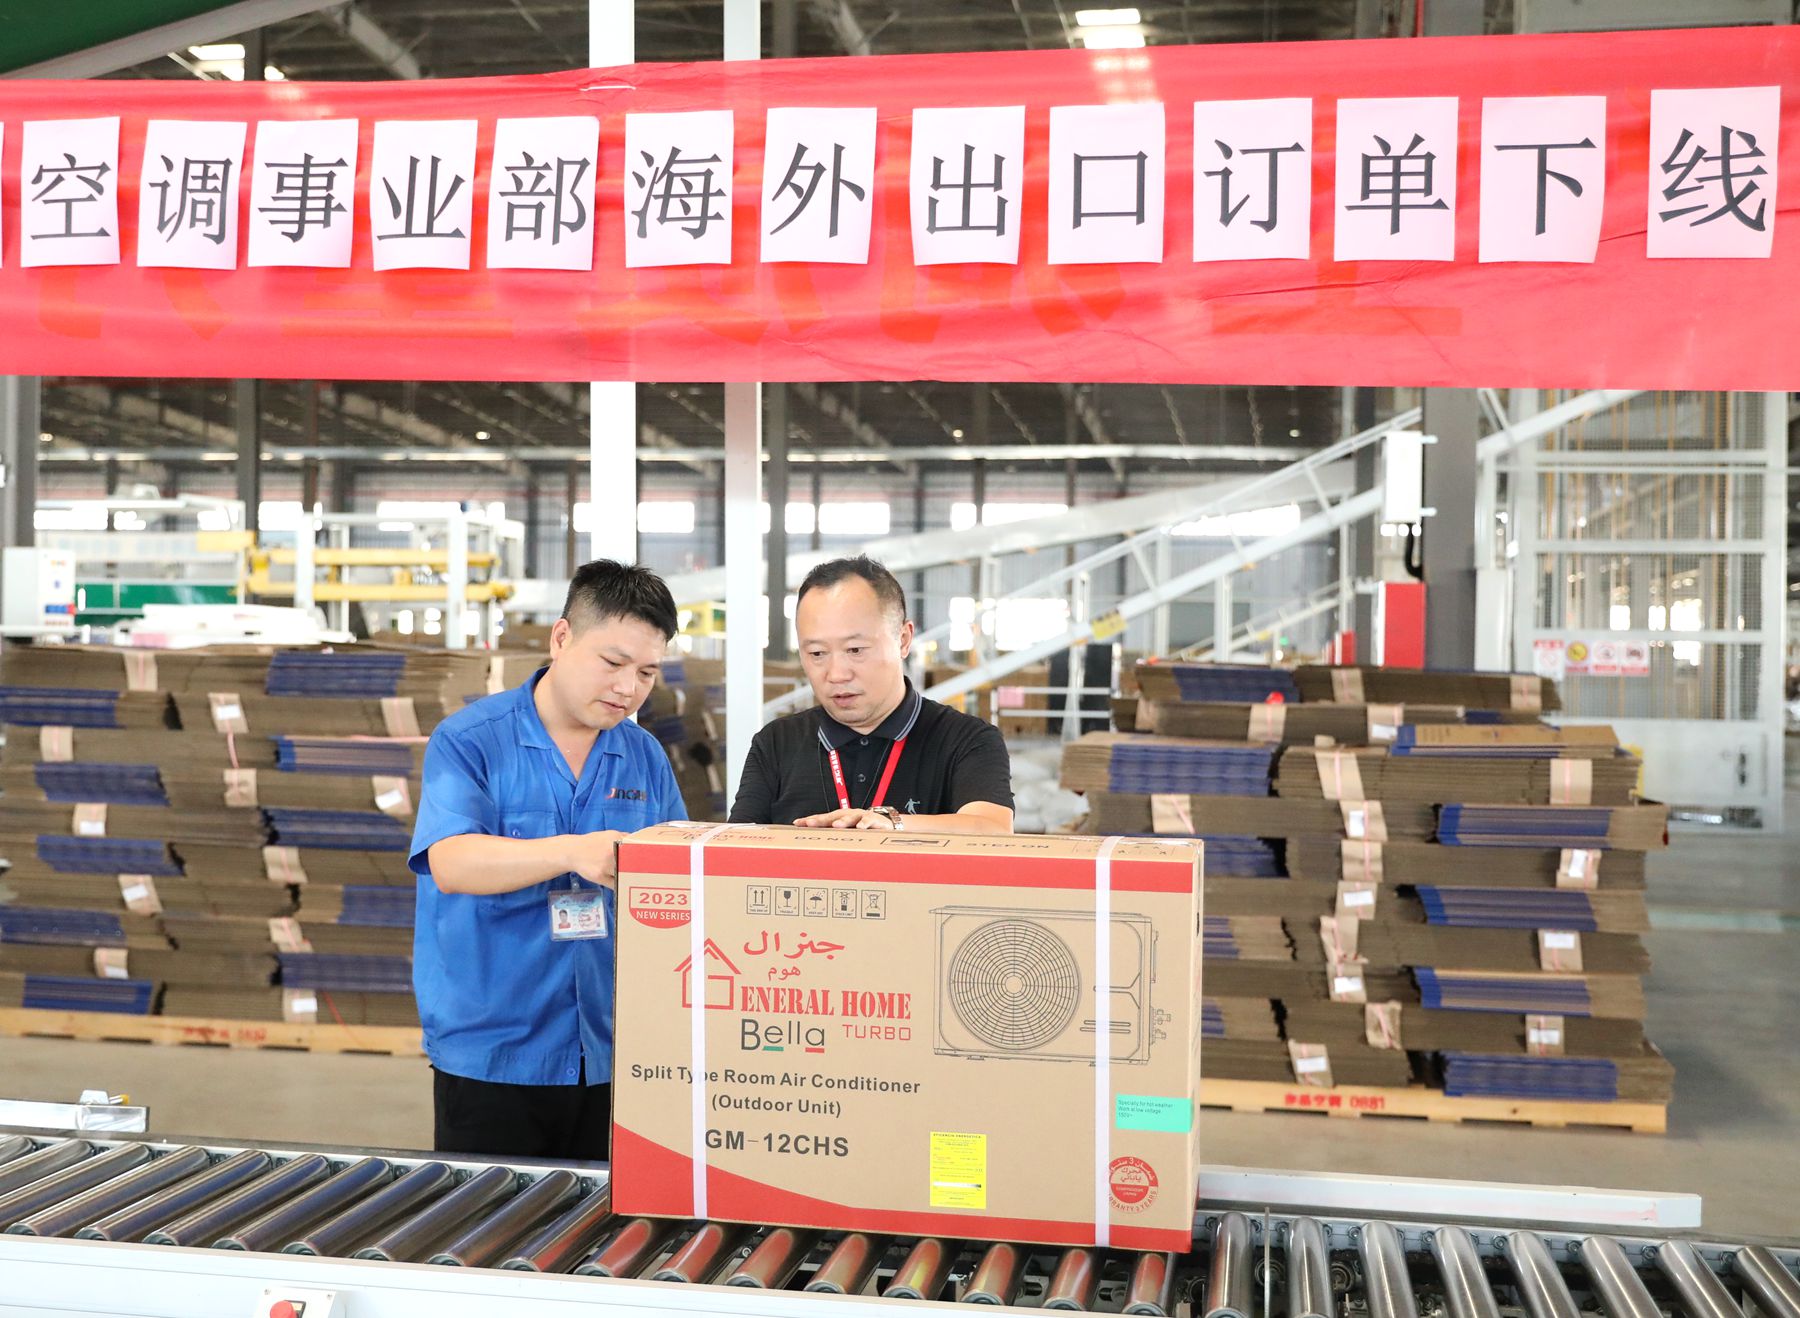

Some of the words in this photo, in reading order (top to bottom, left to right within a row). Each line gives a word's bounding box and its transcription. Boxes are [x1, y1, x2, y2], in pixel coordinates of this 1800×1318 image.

[30, 125, 1769, 246] 空调事业部海外出口订单下线
[639, 892, 688, 906] 2023
[636, 911, 659, 920] NEW
[660, 912, 691, 921] SERIES
[768, 965, 801, 982] هوم
[841, 990, 911, 1019] HOME
[741, 1018, 825, 1052] Bella
[842, 1024, 911, 1041] TURBO
[631, 1064, 673, 1082] Split
[677, 1066, 719, 1084] Tye
[724, 1069, 775, 1085] Room
[780, 1072, 806, 1088] Air
[811, 1074, 920, 1094] Conditioner
[712, 1094, 793, 1113] (Outdoor
[798, 1099, 842, 1119] Unit)
